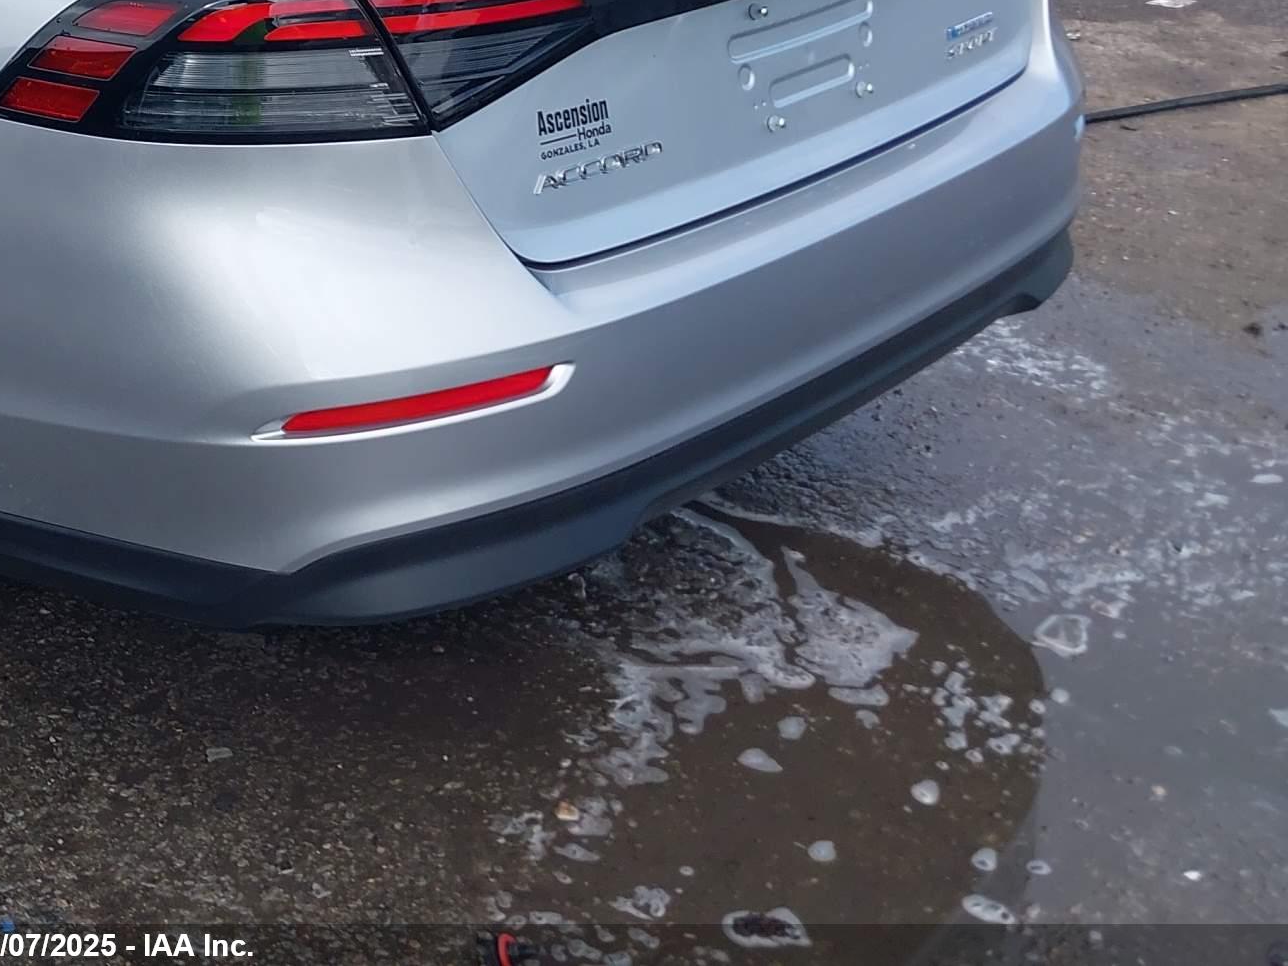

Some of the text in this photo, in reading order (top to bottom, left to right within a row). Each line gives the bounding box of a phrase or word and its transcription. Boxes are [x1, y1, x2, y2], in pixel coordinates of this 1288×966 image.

[537, 99, 609, 136] Ascension
[577, 122, 611, 141] Honda
[540, 138, 600, 160] GONZALES, LA
[533, 142, 662, 195] ACCORD
